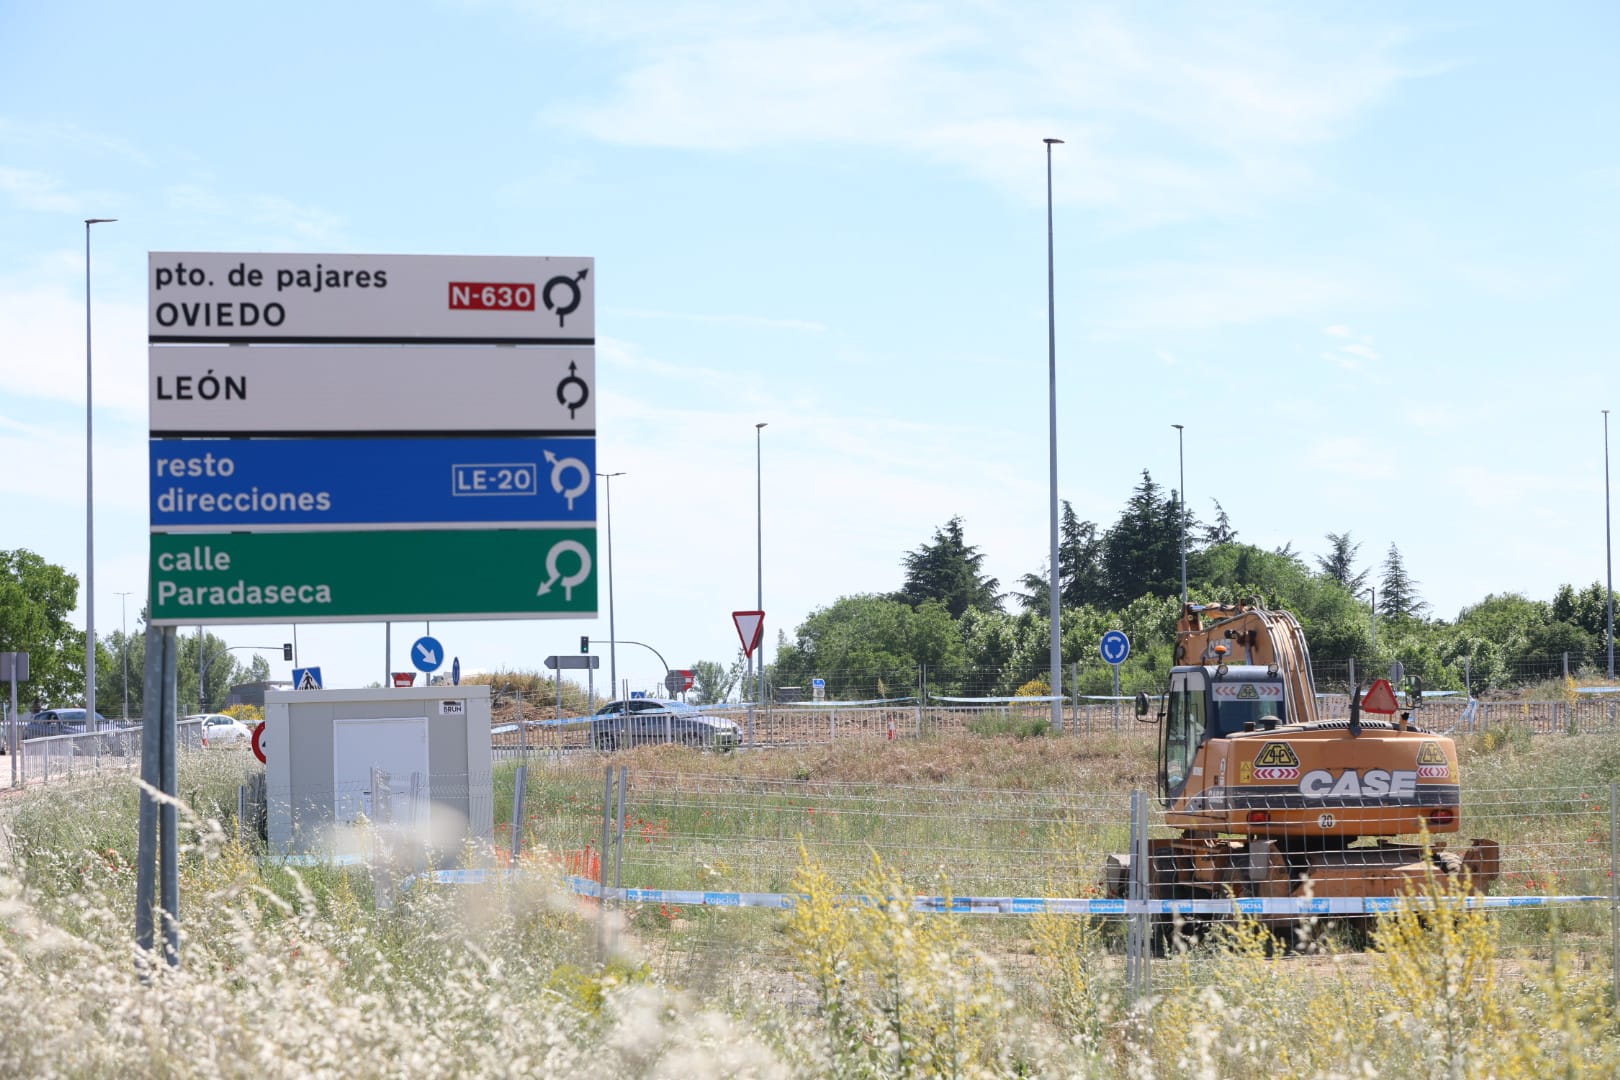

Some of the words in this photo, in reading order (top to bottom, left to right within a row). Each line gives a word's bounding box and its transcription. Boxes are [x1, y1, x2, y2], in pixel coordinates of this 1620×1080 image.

[155, 263, 214, 291] pto.
[228, 263, 263, 287] de
[277, 264, 388, 293] pajares
[450, 286, 532, 307] N-630
[156, 302, 286, 327] OVIEDO
[157, 370, 247, 400] LEÓN
[157, 453, 235, 477] resto
[458, 470, 531, 491] LE-20
[157, 488, 331, 513] direcciones
[158, 546, 231, 571] calle
[158, 581, 332, 606] Paradaseca
[1300, 769, 1417, 798] CASE
[1321, 814, 1334, 828] 20
